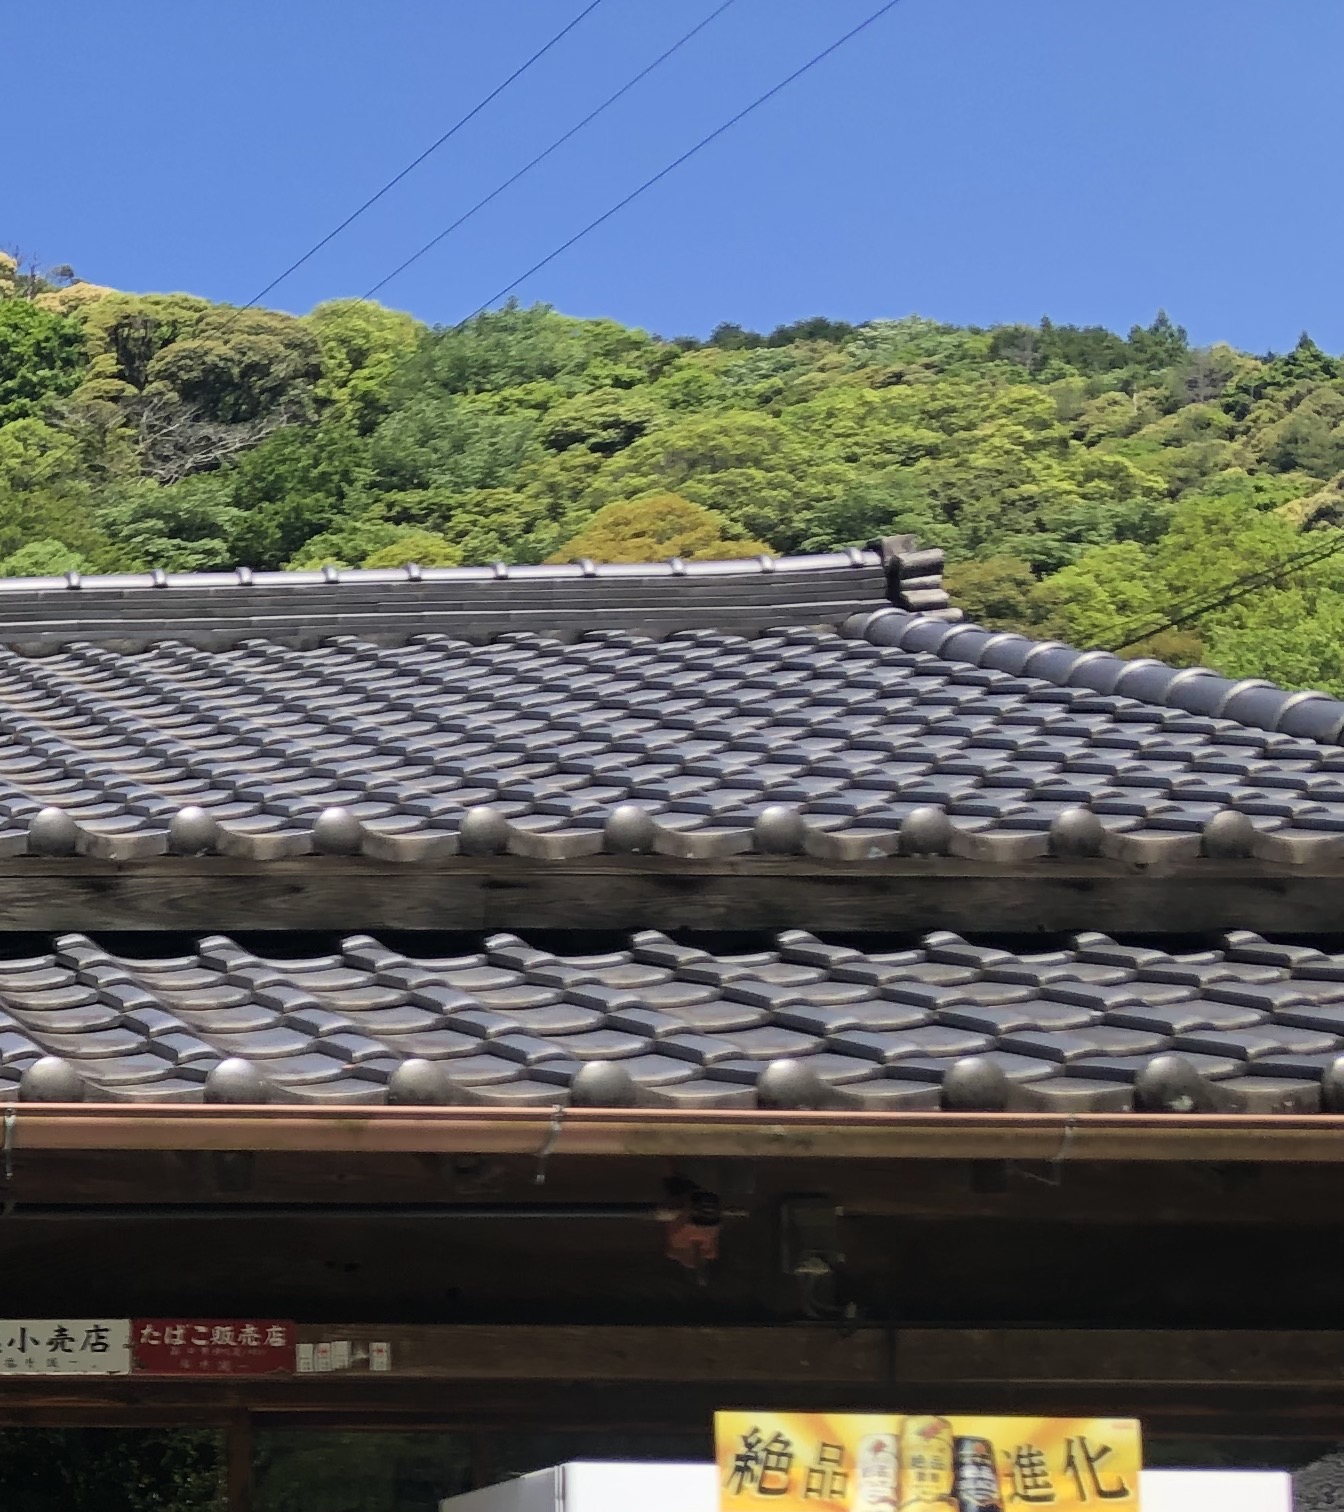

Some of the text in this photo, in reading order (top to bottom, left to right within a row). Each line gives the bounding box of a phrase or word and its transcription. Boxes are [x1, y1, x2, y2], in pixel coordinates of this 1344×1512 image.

[140, 1323, 287, 1347] たばこ販売店
[724, 1426, 1130, 1503] 絶品 進化
